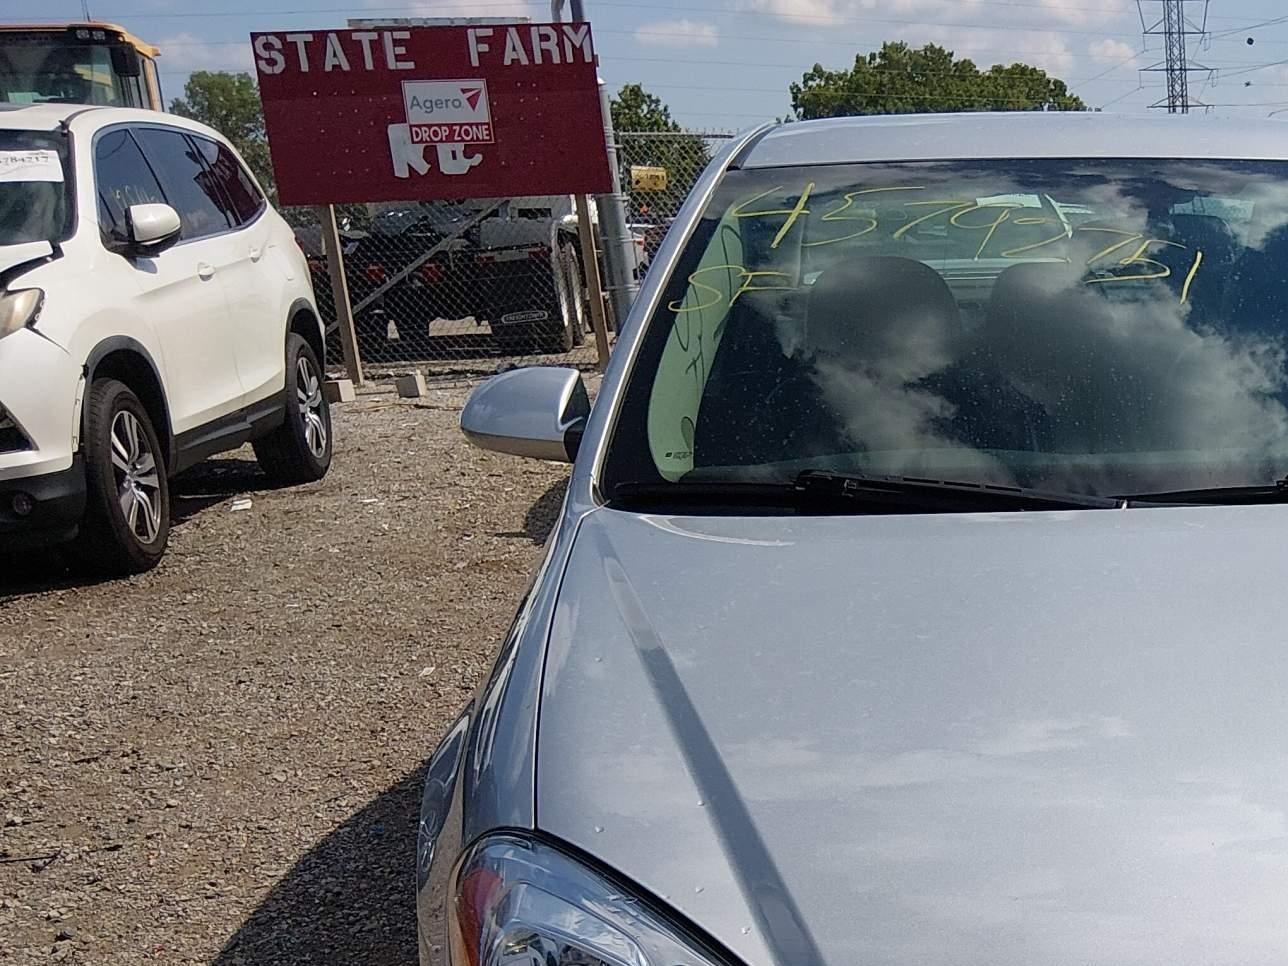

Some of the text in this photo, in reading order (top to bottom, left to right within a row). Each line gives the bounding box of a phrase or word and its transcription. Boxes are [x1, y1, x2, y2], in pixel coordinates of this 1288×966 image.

[254, 25, 592, 74] STATE FARM
[409, 96, 462, 114] Agero
[411, 124, 491, 142] DROP ZONE
